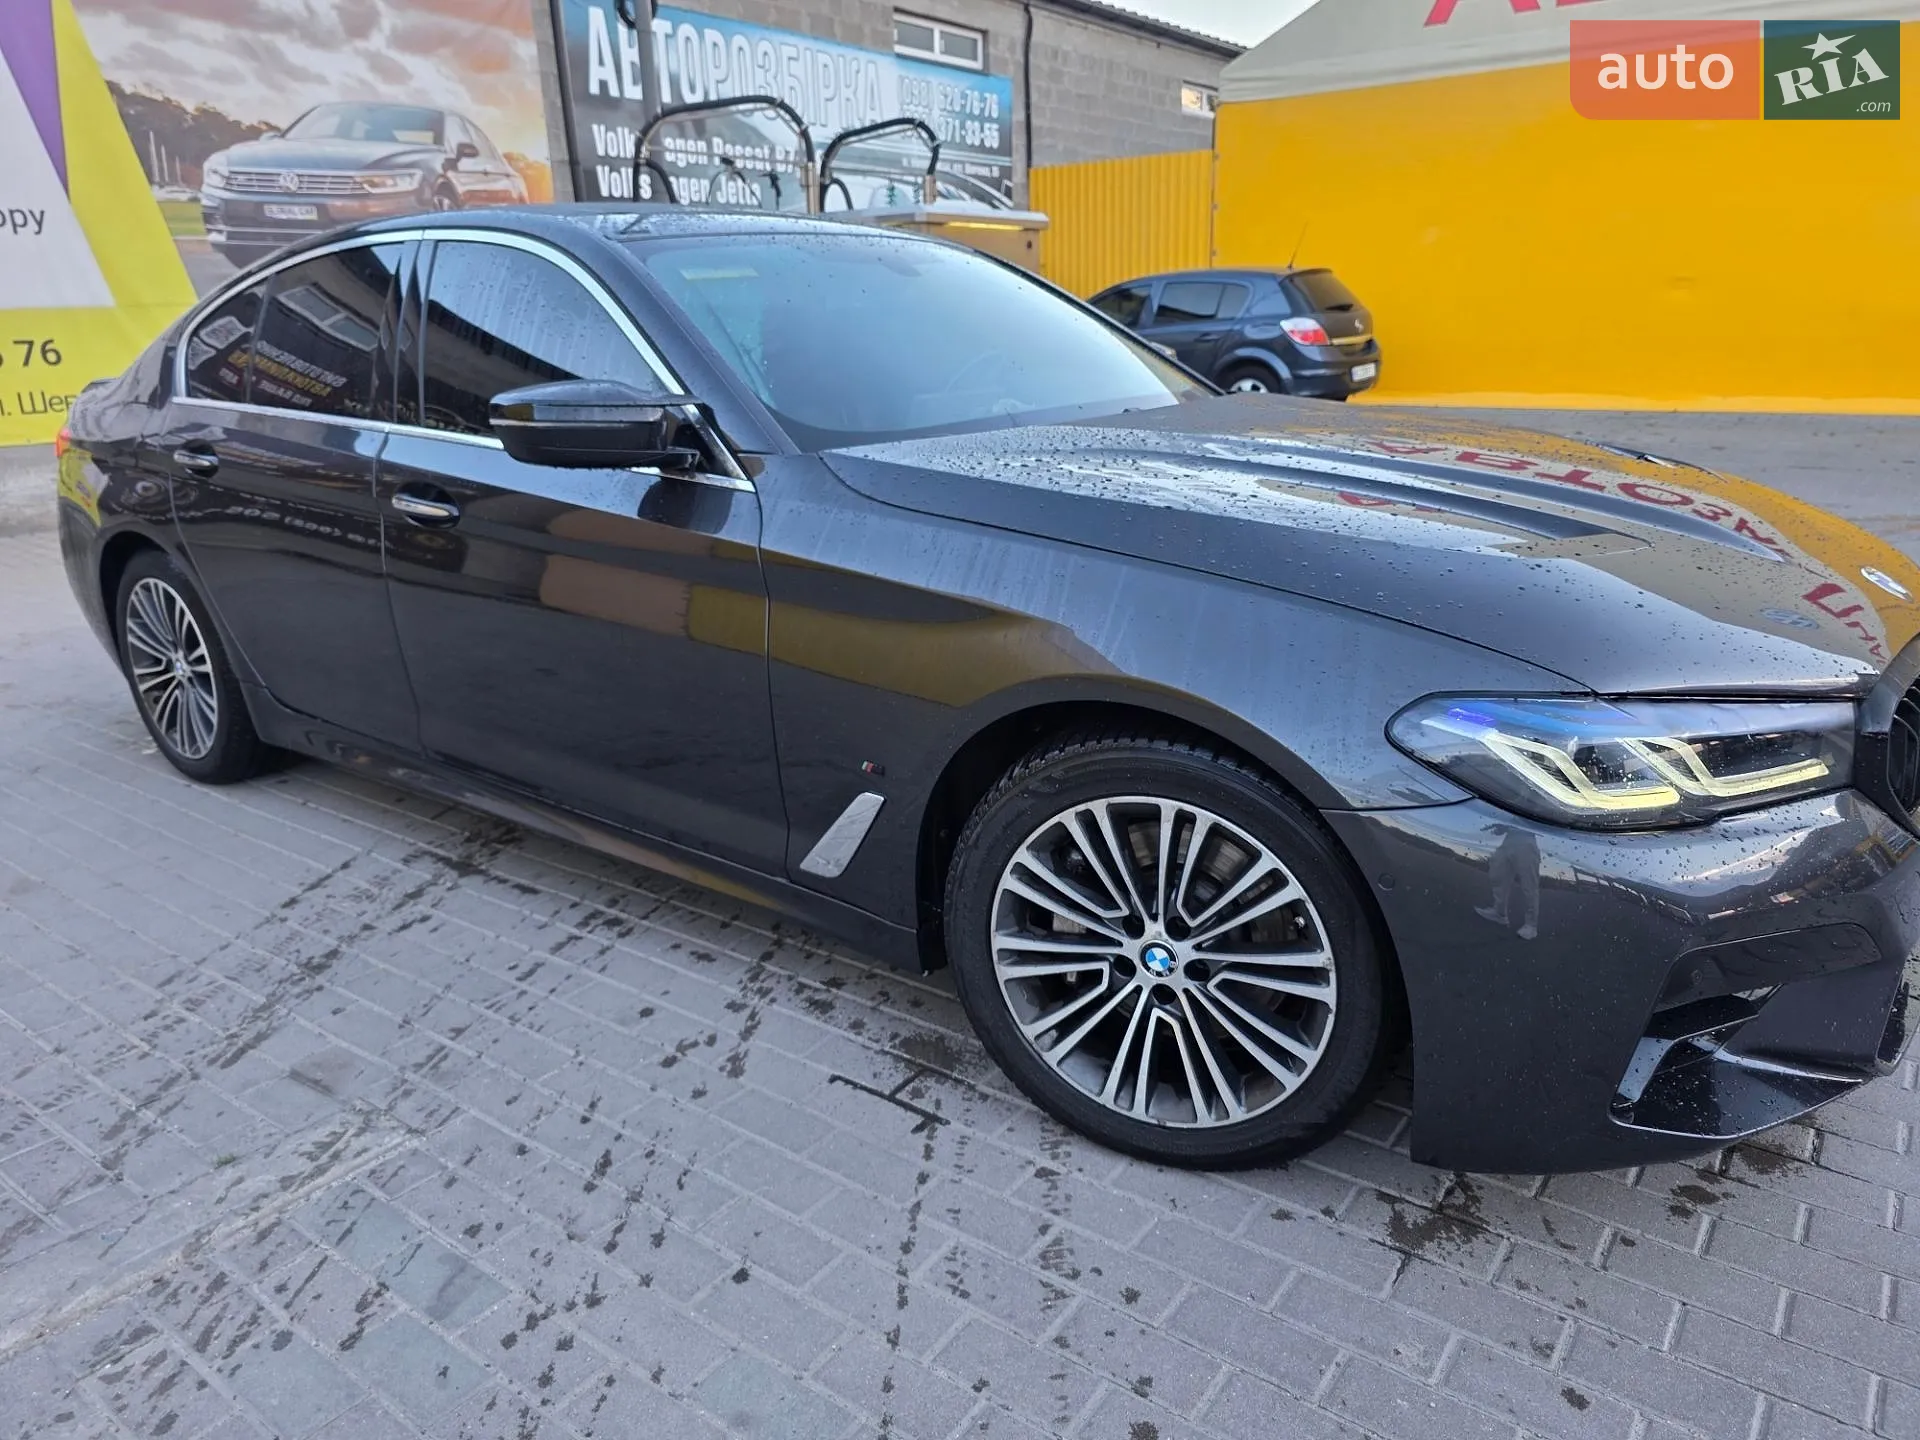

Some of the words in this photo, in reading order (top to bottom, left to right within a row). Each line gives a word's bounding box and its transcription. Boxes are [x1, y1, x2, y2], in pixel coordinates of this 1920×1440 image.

[588, 6, 884, 129] АВТОРОЗБІРКА
[592, 123, 709, 168] Volkagen
[13, 339, 62, 367] 76
